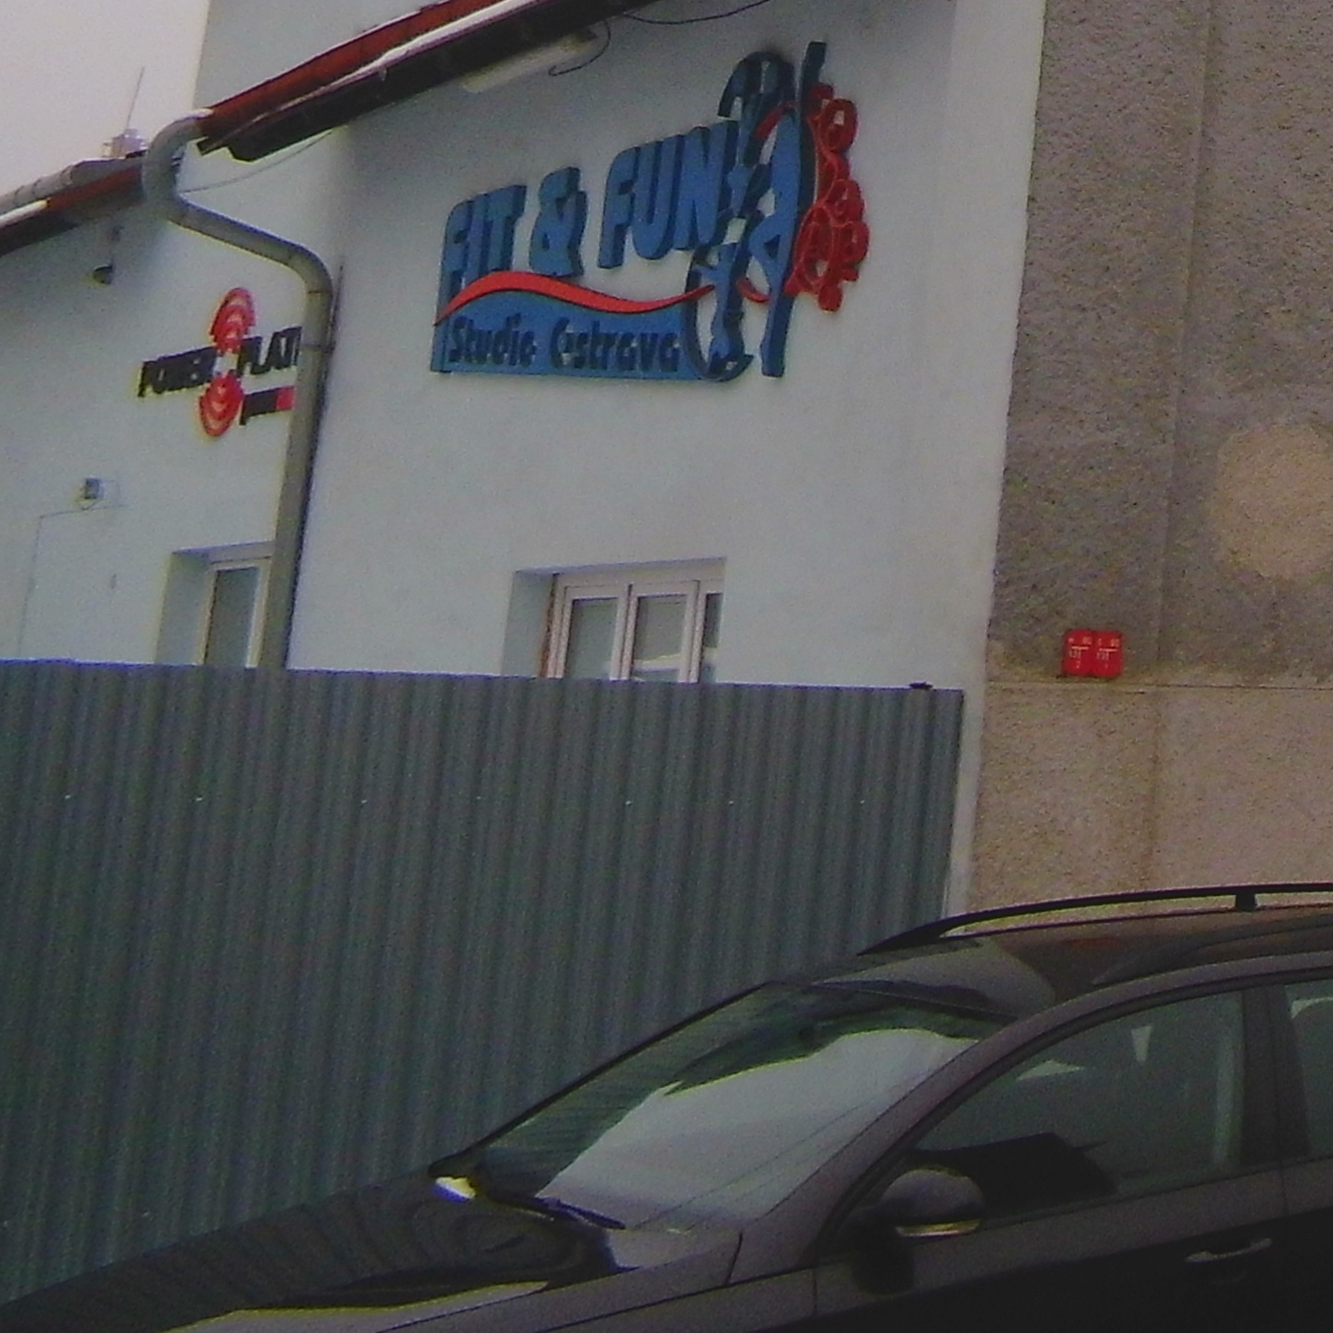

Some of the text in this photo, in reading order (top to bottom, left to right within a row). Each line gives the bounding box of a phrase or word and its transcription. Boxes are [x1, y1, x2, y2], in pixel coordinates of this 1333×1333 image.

[437, 120, 738, 316] FIT & FUN
[237, 326, 302, 378] PLAT
